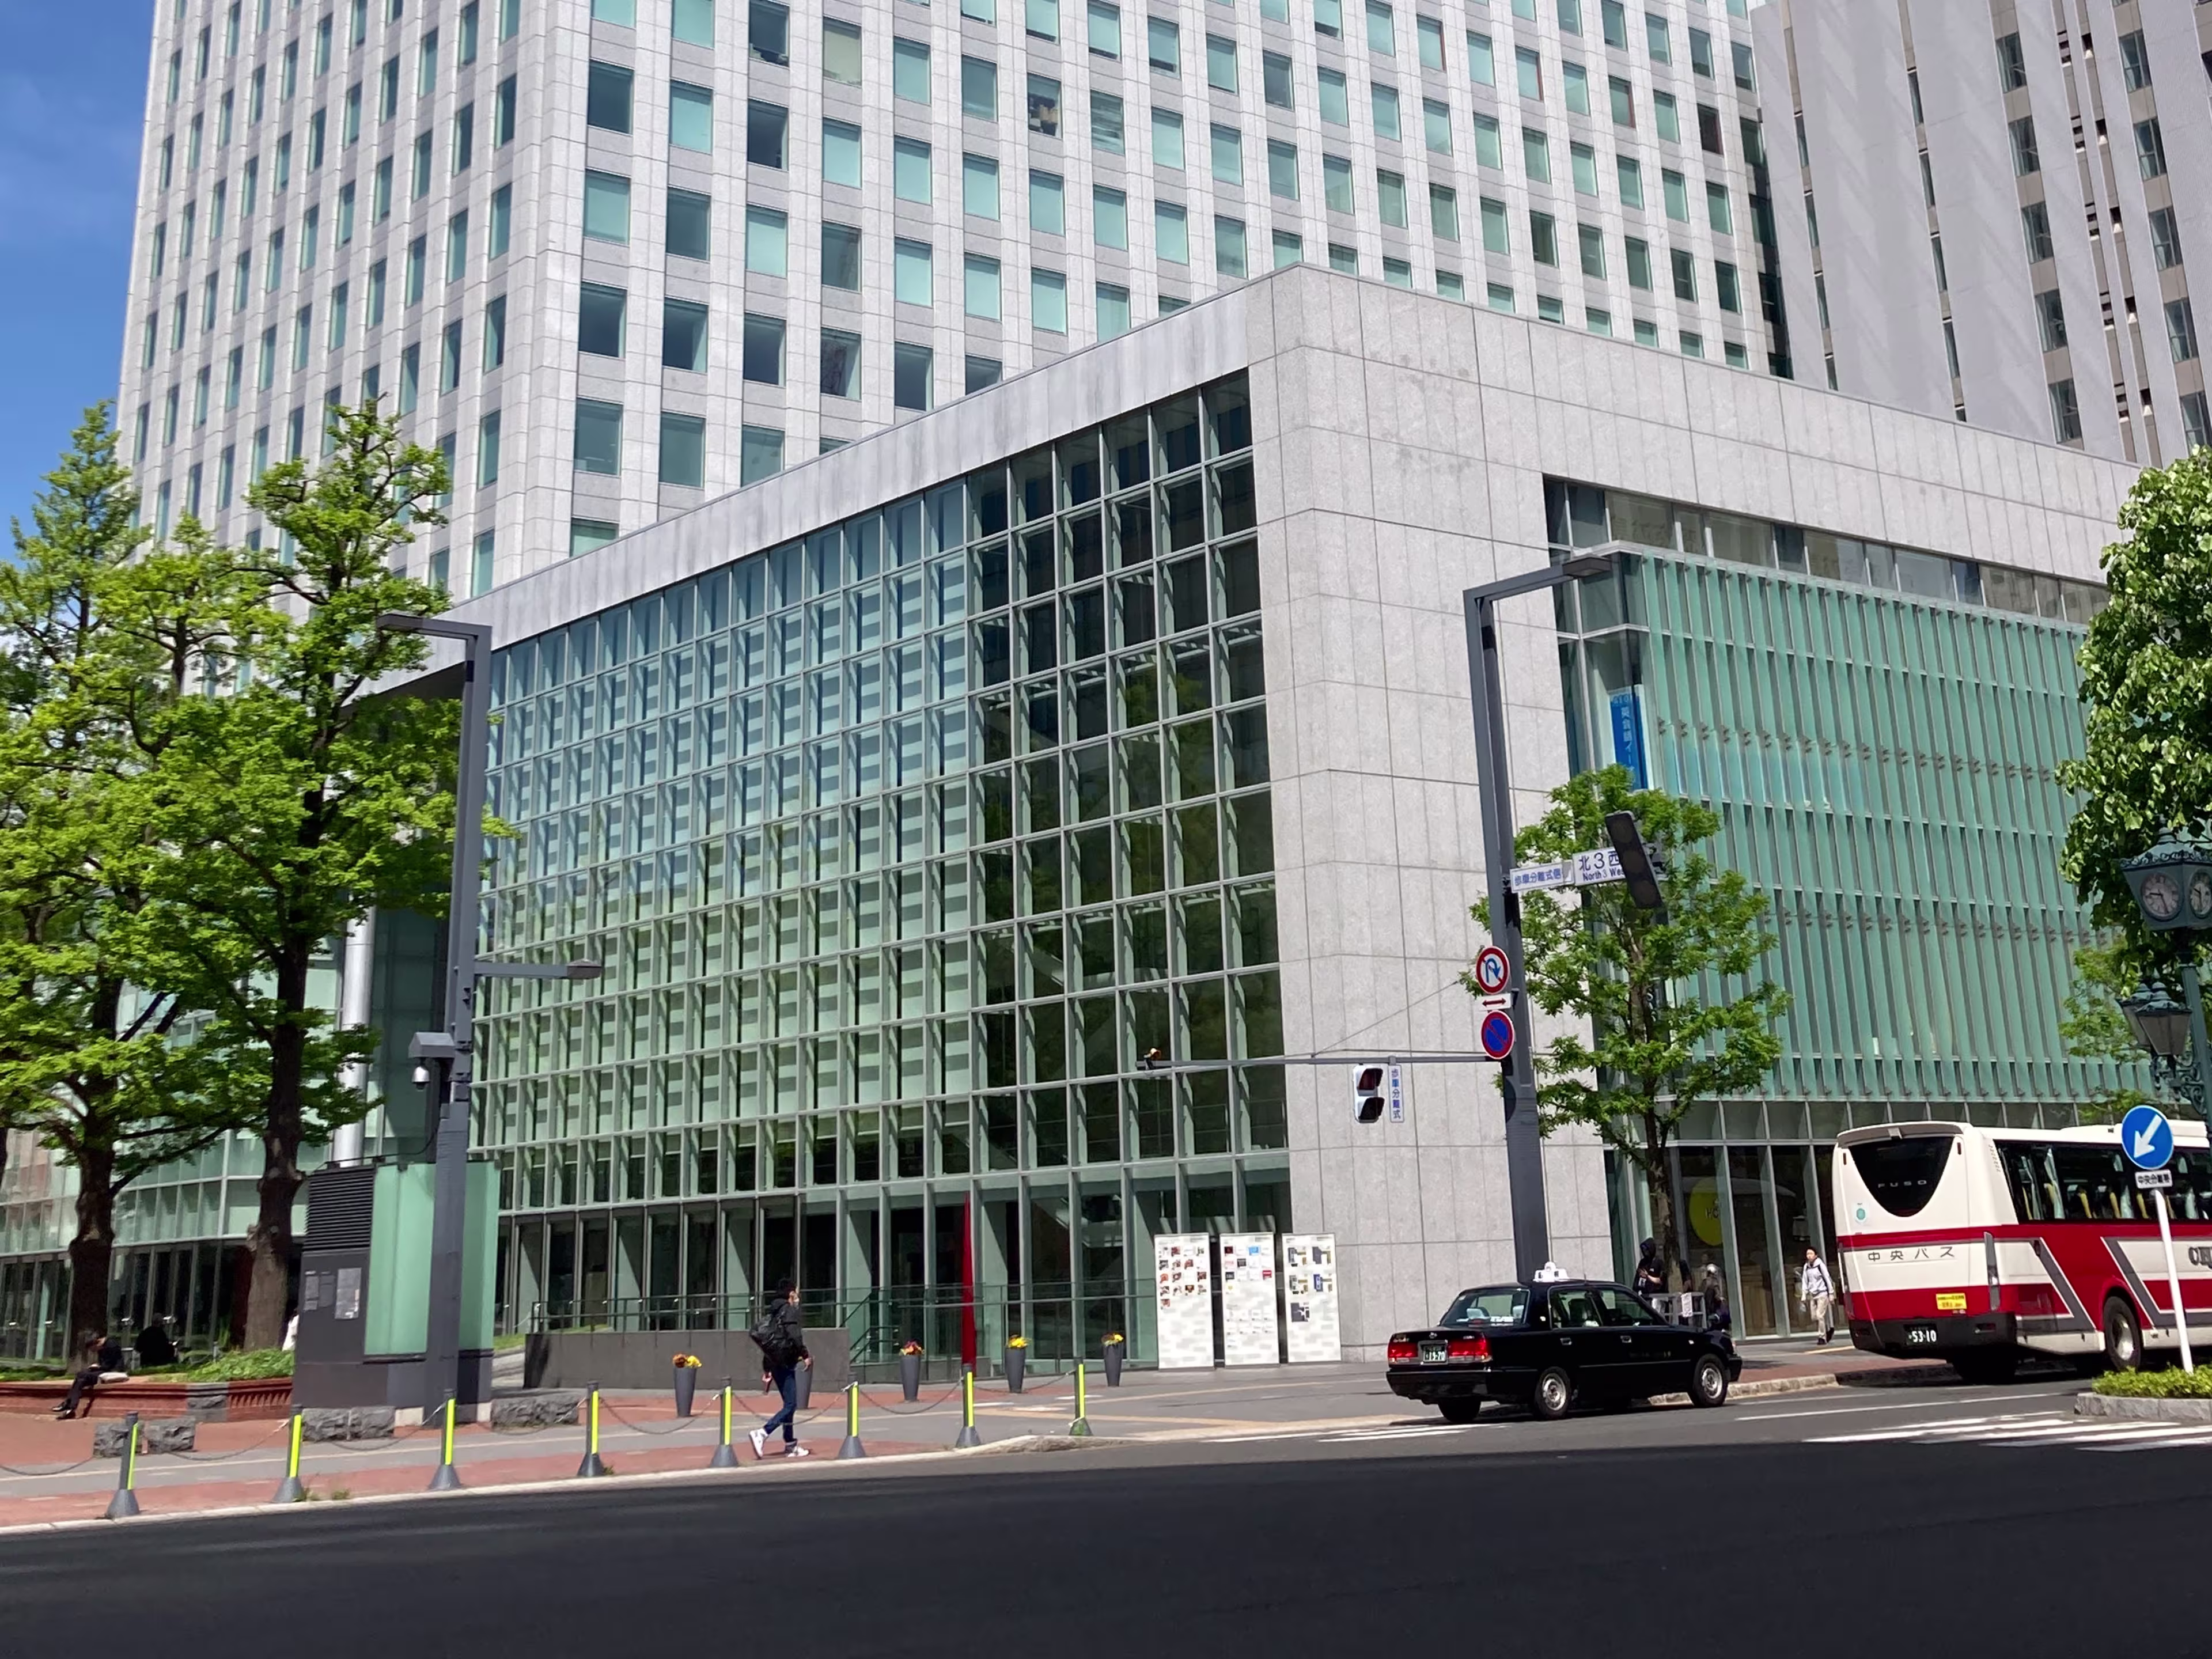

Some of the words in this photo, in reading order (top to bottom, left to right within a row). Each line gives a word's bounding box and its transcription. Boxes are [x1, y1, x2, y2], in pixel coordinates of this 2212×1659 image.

[1582, 870, 1601, 881] North
[1603, 869, 1607, 878] 3
[1868, 1246, 1955, 1262] 中央バス
